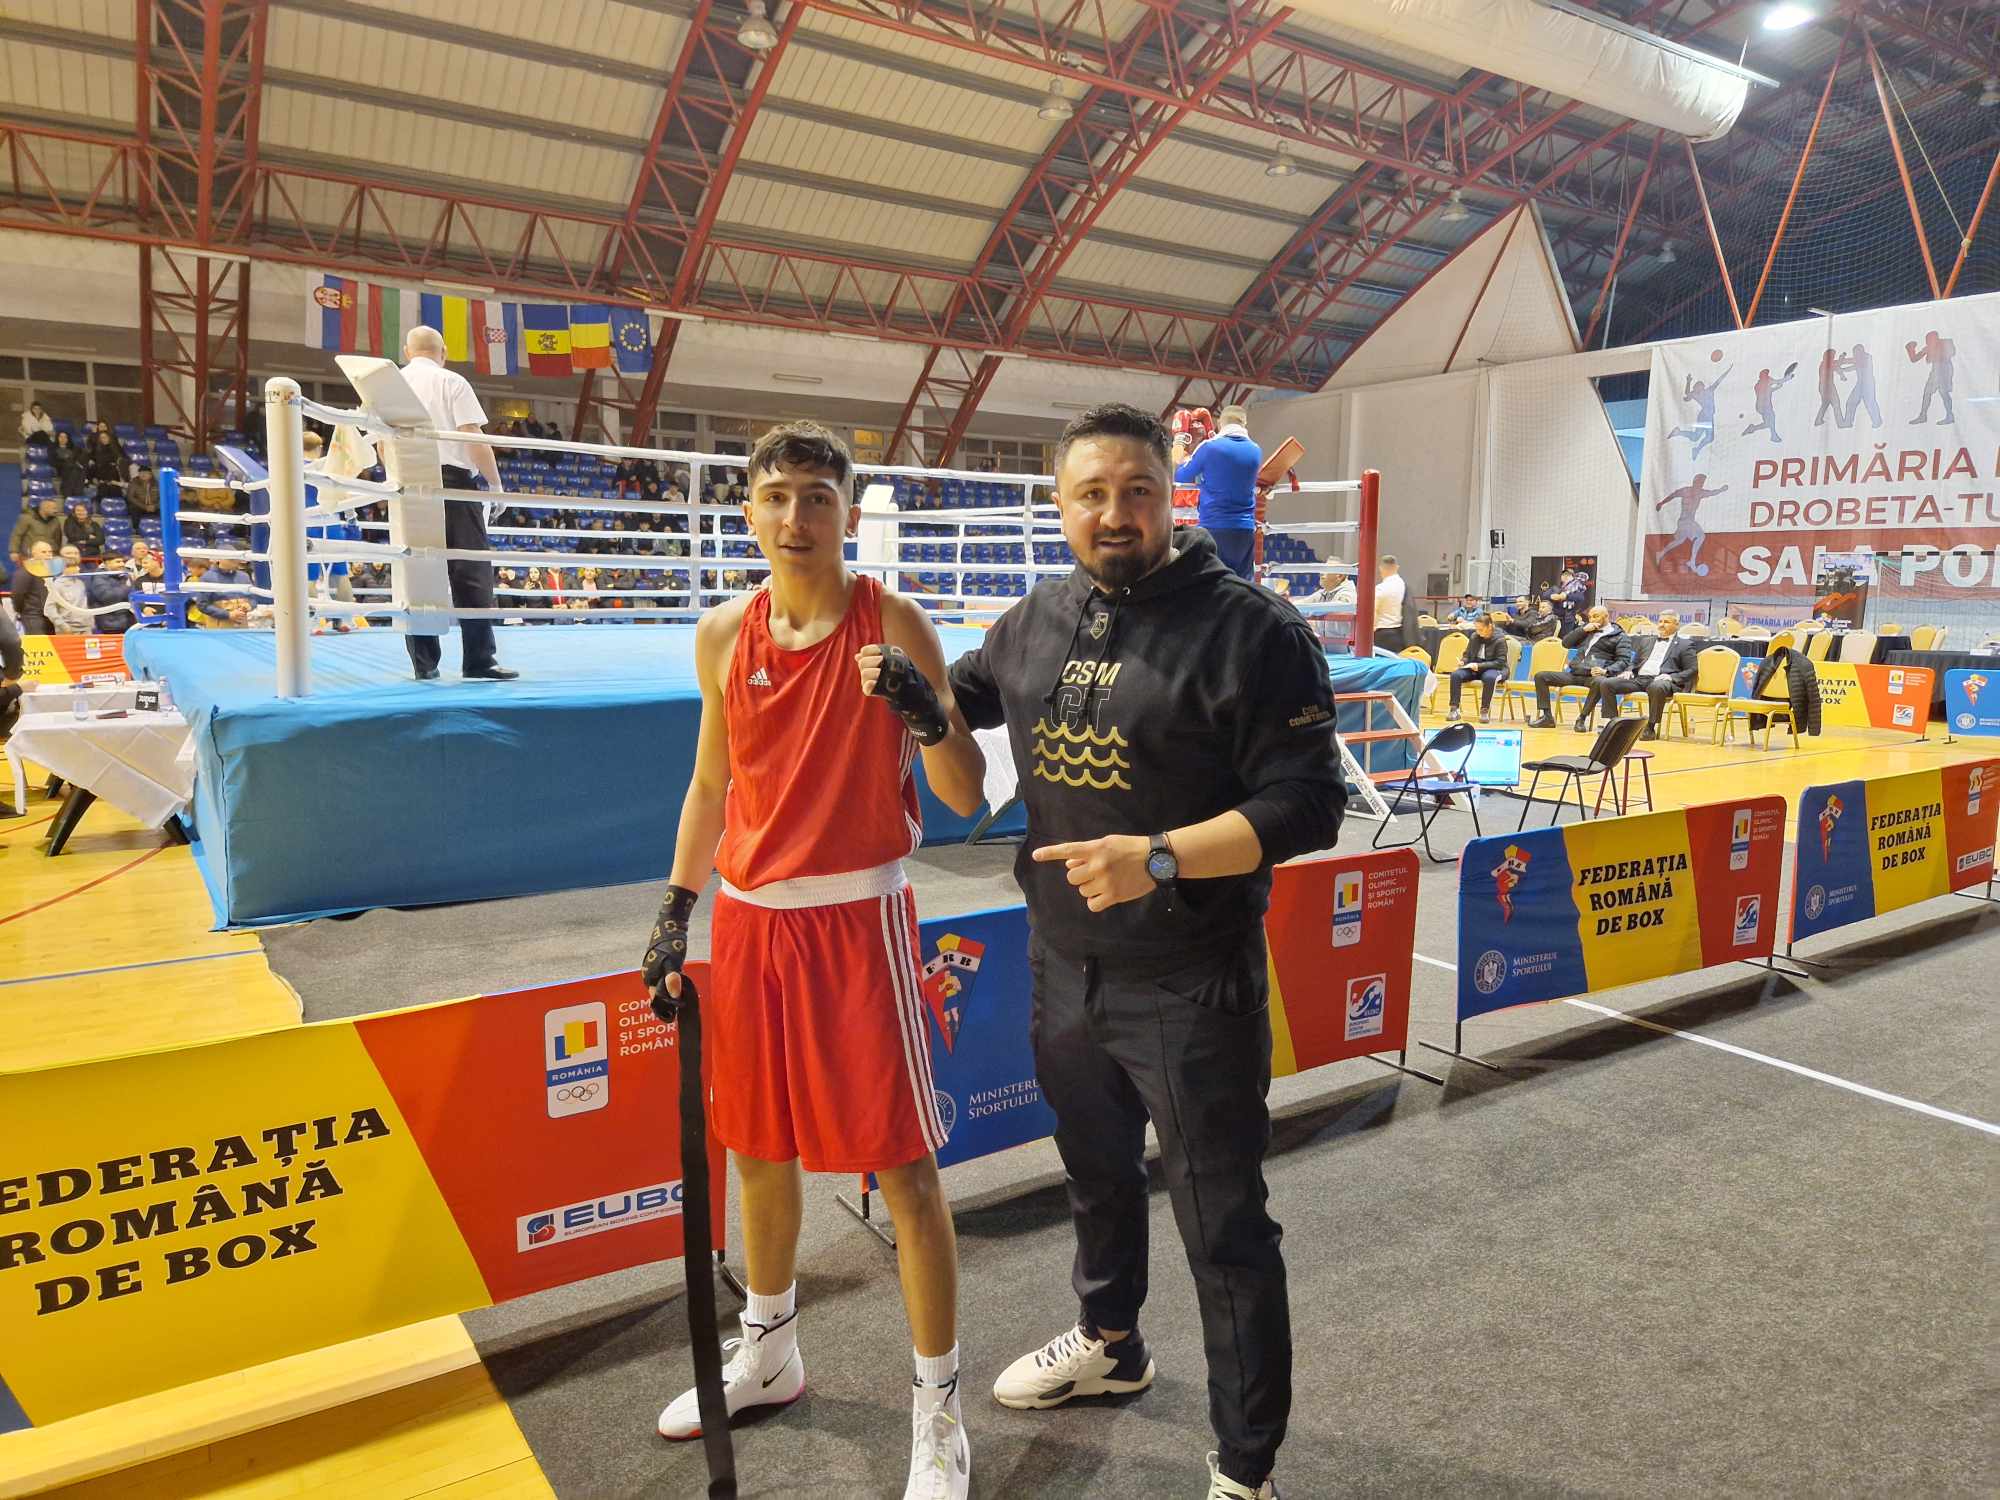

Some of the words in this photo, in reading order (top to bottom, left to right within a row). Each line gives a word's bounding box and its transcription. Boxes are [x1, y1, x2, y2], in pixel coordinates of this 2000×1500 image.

[1752, 442, 1978, 489] PRIMĂRIA
[747, 678, 772, 686] adidas
[1062, 660, 1122, 686] CSM
[1870, 803, 1942, 832] FEDERAȚIA
[1578, 853, 1688, 887] FEDERAȚIA
[1882, 853, 1899, 871] DE
[1901, 846, 1926, 866] BOX
[1589, 876, 1673, 911] ROMÂNĂ
[1596, 915, 1623, 936] DE
[1627, 908, 1665, 931] BOX
[618, 998, 652, 1013] COM
[619, 1031, 633, 1046] ȘI
[637, 1022, 677, 1038] SPOR
[620, 1037, 674, 1056] ROMÂN
[551, 1065, 604, 1081] ROMÂNIA
[968, 1091, 1039, 1120] SPORTULUI
[0, 1106, 391, 1216] EDERAȚIA
[0, 1158, 344, 1271] ROMÂNĂ
[34, 1259, 144, 1316] DE
[164, 1218, 319, 1285] BOX
